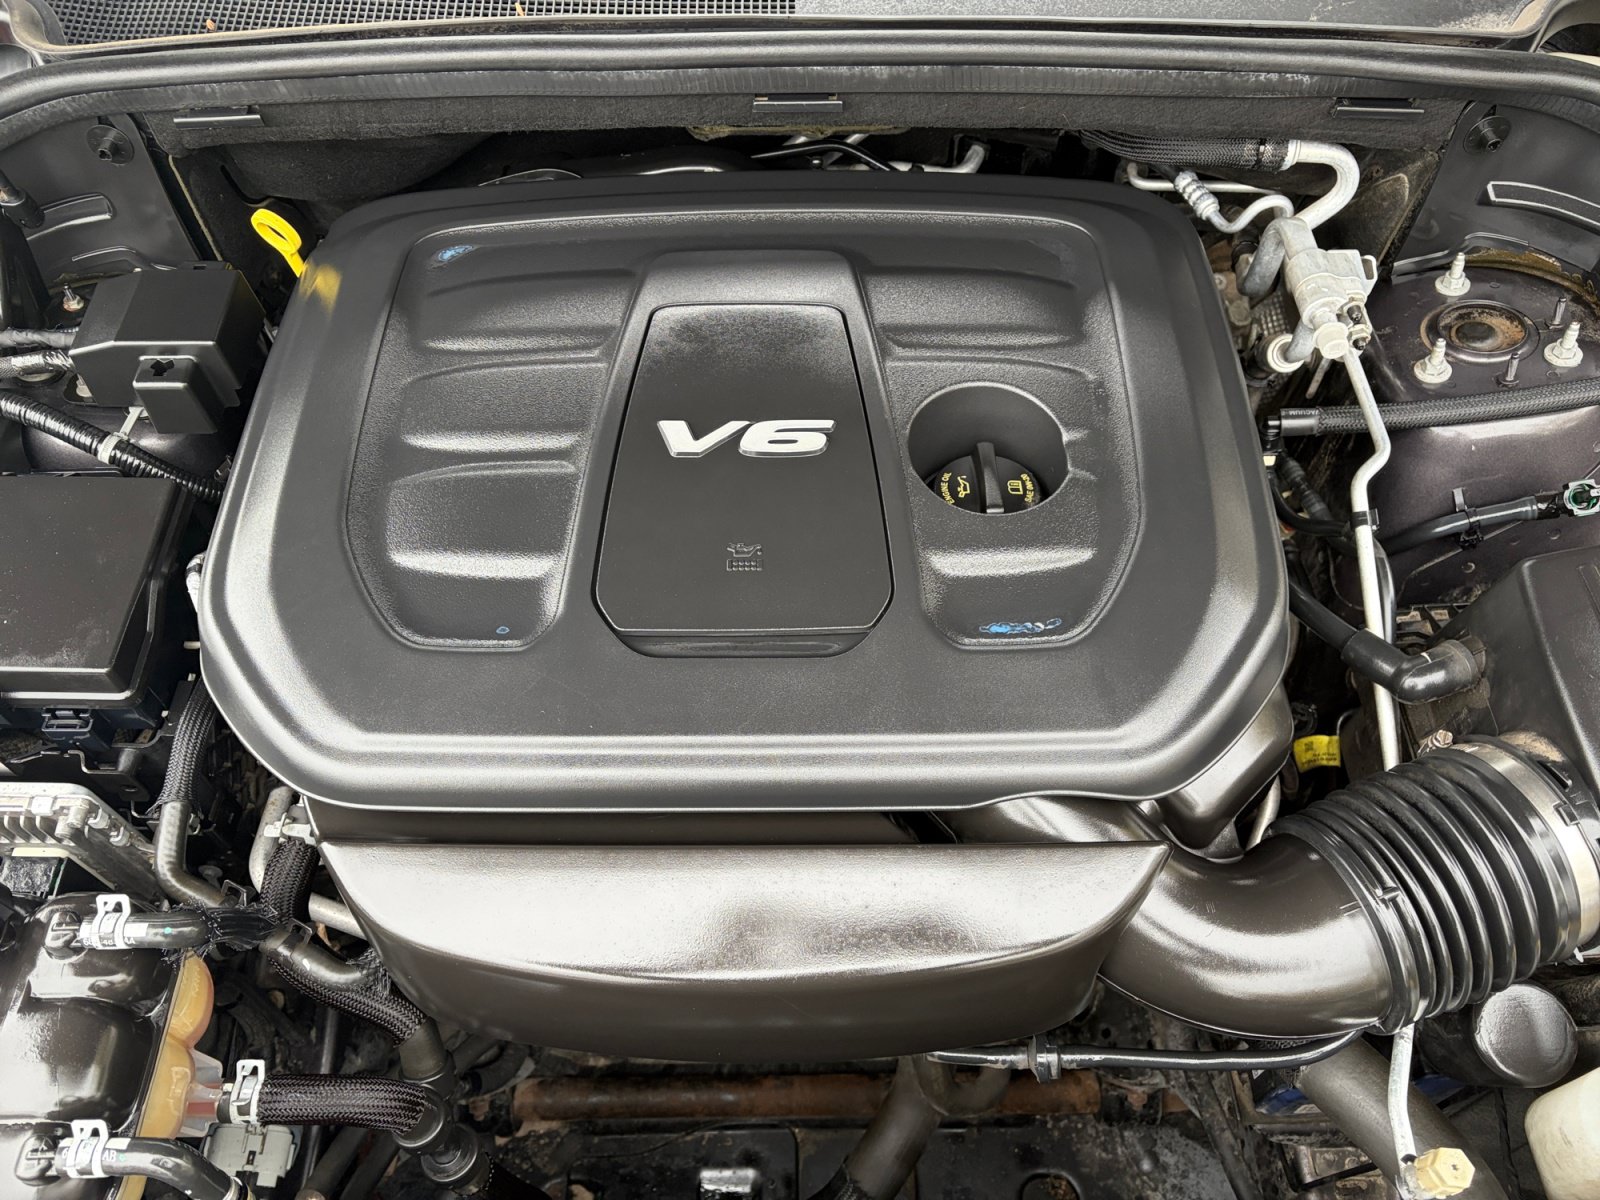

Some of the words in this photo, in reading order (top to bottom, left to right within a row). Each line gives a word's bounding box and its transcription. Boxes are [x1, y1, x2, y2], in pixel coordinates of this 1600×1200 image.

[657, 419, 836, 458] V6
[941, 472, 952, 482] OIL
[940, 481, 956, 505] ENGINE
[1024, 490, 1035, 503] SAE
